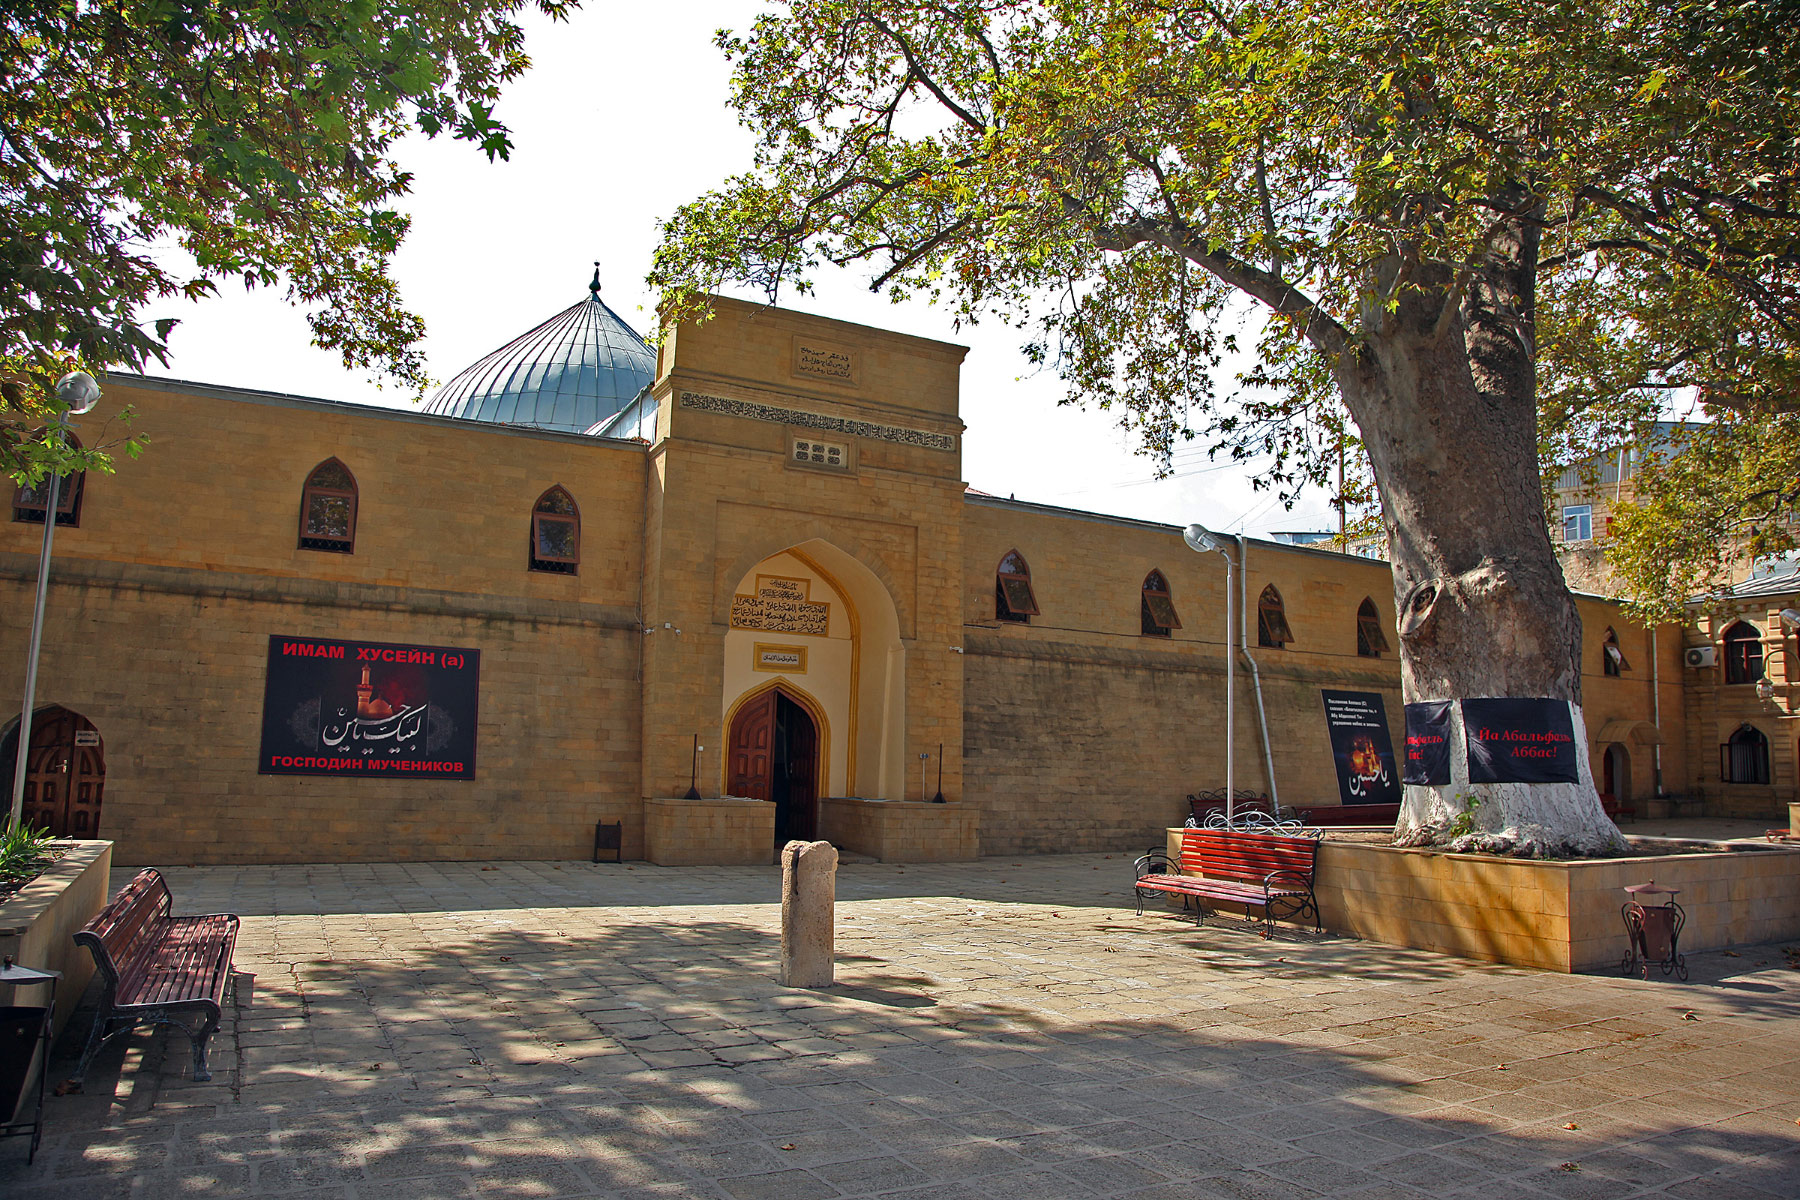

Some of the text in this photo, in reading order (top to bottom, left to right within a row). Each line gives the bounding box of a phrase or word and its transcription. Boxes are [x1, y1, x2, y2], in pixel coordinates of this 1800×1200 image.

[282, 642, 465, 669] ИМАМ ХУСЕЙН (а)
[1480, 727, 1499, 741] Йа
[1511, 746, 1558, 758] Аббас!
[271, 755, 465, 773] ГОСПОДИН МУЧЕНИКОВ
